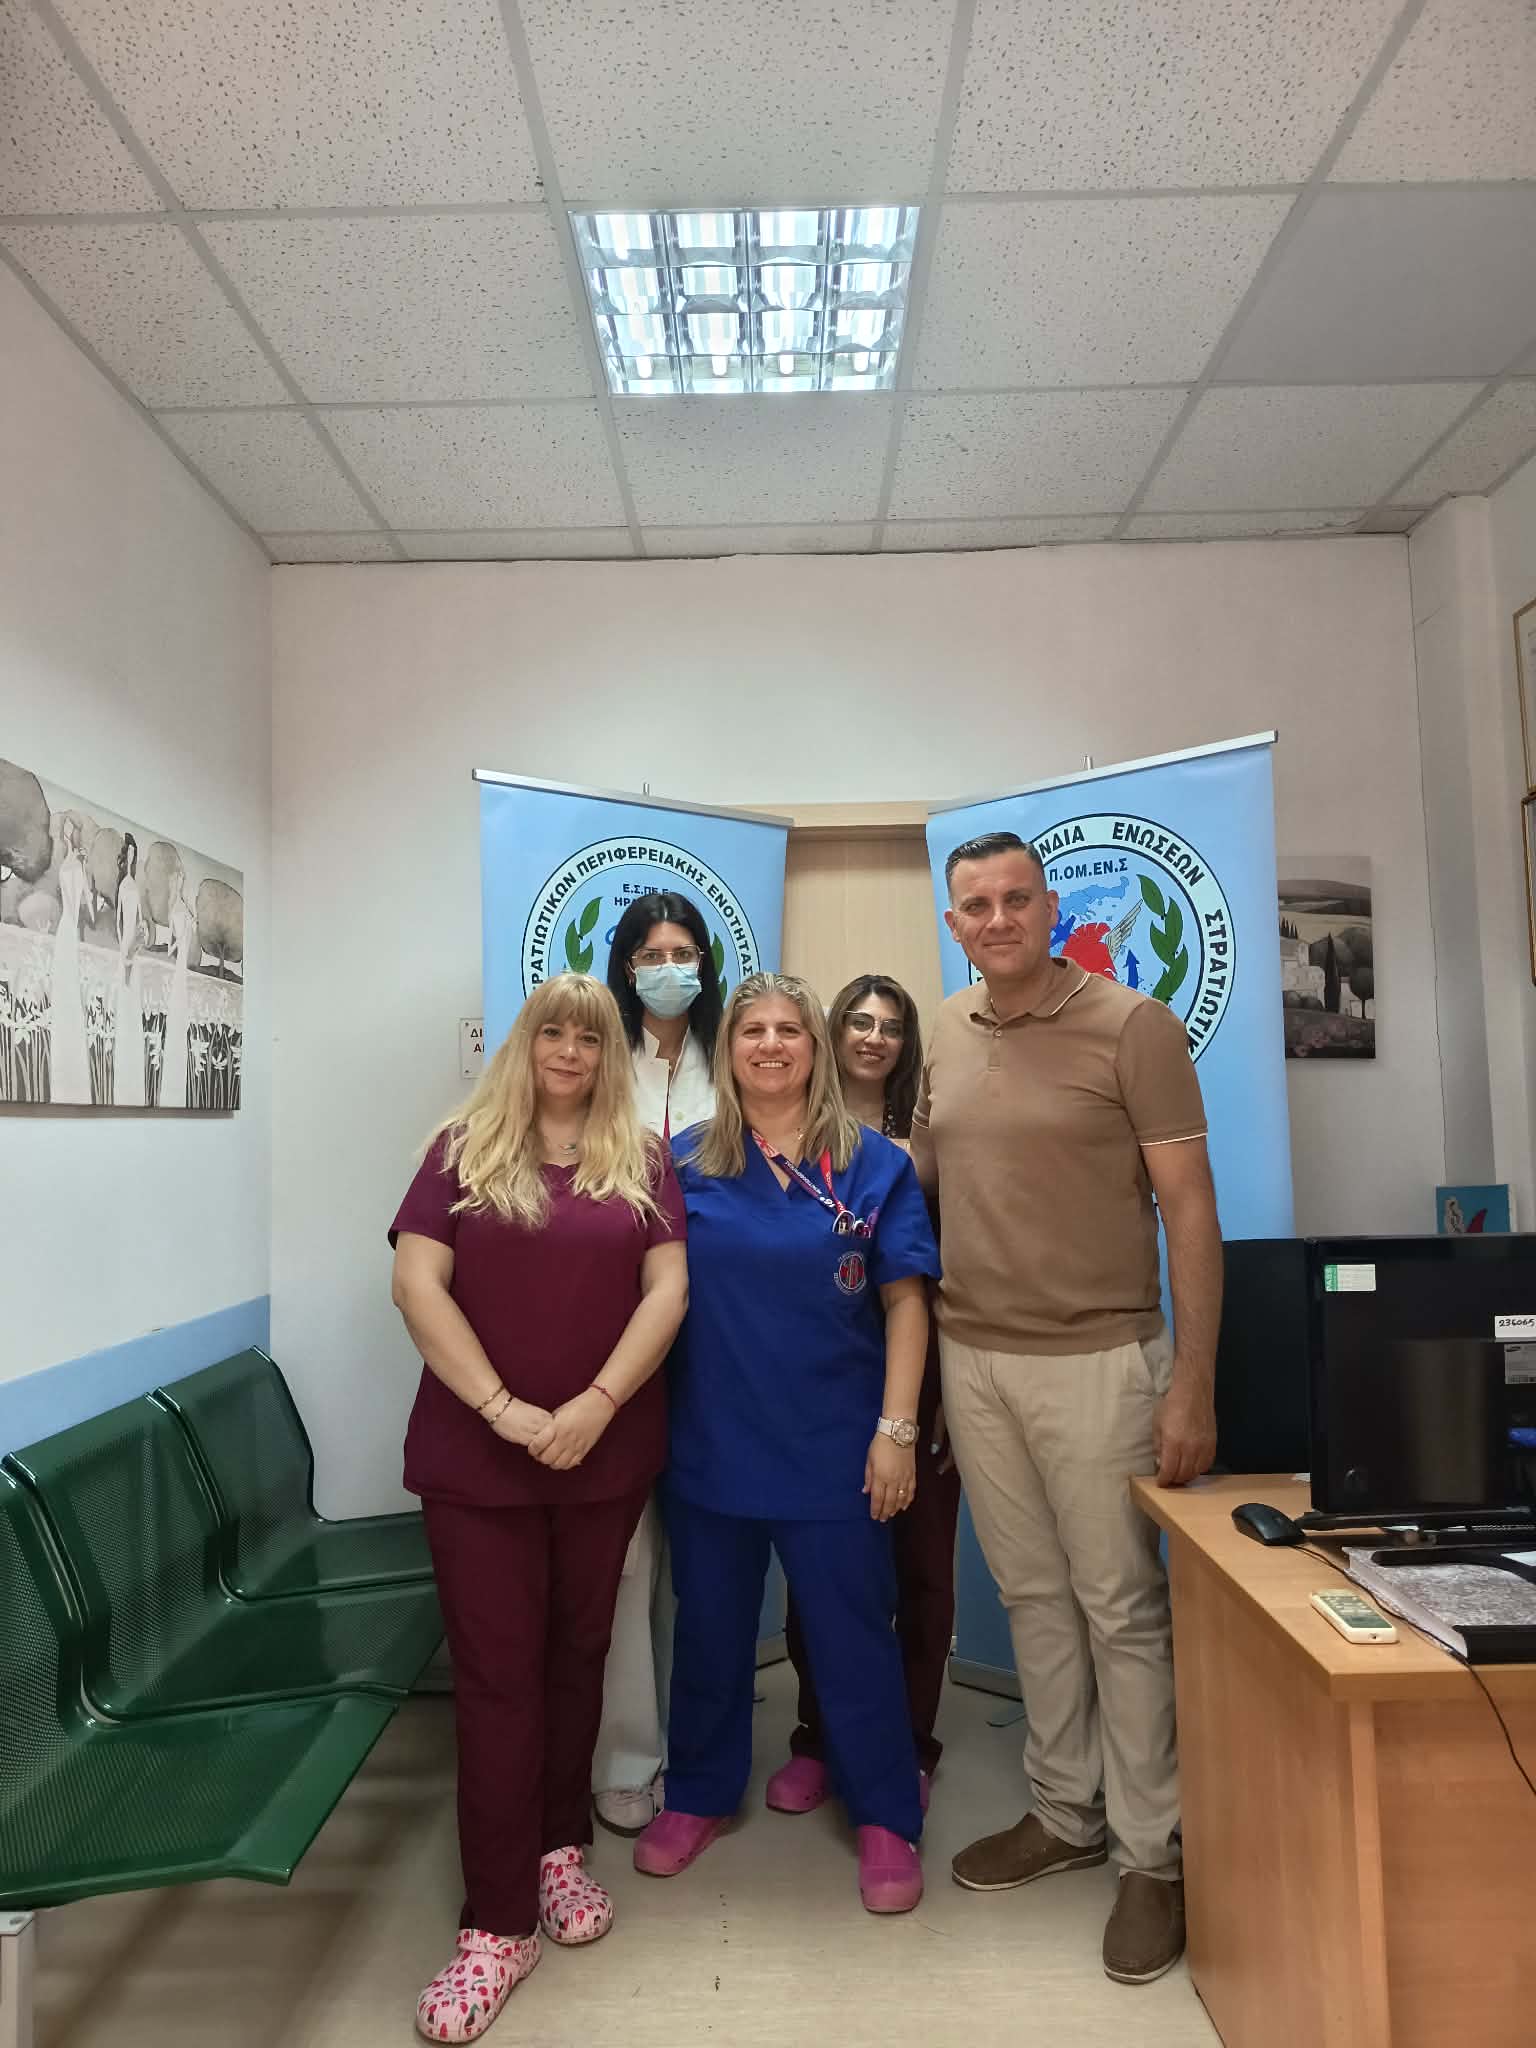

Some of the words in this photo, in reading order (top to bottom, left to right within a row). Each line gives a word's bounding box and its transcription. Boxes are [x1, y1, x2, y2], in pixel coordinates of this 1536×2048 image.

[531, 872, 577, 990] ΡΑΤΙΩΤΙΚΩΝ
[576, 846, 707, 887] ΠΕΡΙΦΕΡΕΙΑΚΗΣ
[707, 884, 753, 976] ΕΝΟΤΗΤΑΣ
[1038, 825, 1085, 858] ΝΔΙΑ
[1112, 821, 1205, 887] ΕΝΩΣΕΩΝ
[1188, 909, 1228, 1055] ΣΤΡΑΤΙΩΤΙΚ
